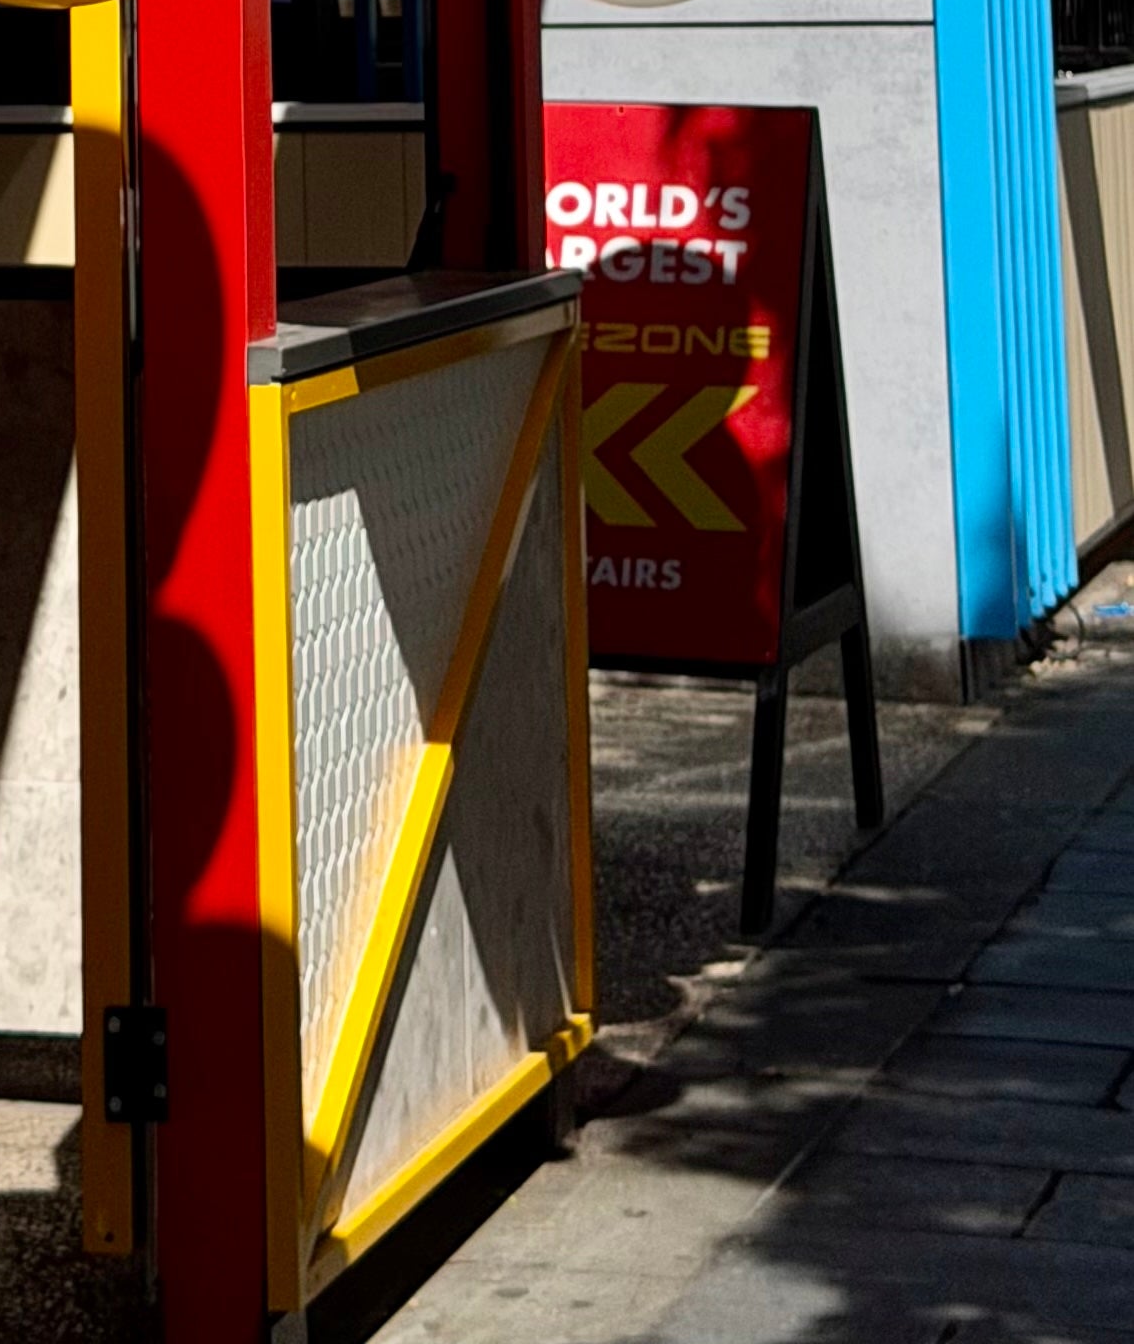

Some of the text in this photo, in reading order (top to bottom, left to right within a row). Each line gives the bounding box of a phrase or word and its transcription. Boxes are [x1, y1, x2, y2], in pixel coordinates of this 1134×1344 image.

[545, 181, 751, 230] ORLD'S
[546, 235, 748, 285] RGEST
[586, 555, 682, 590] AIRS
